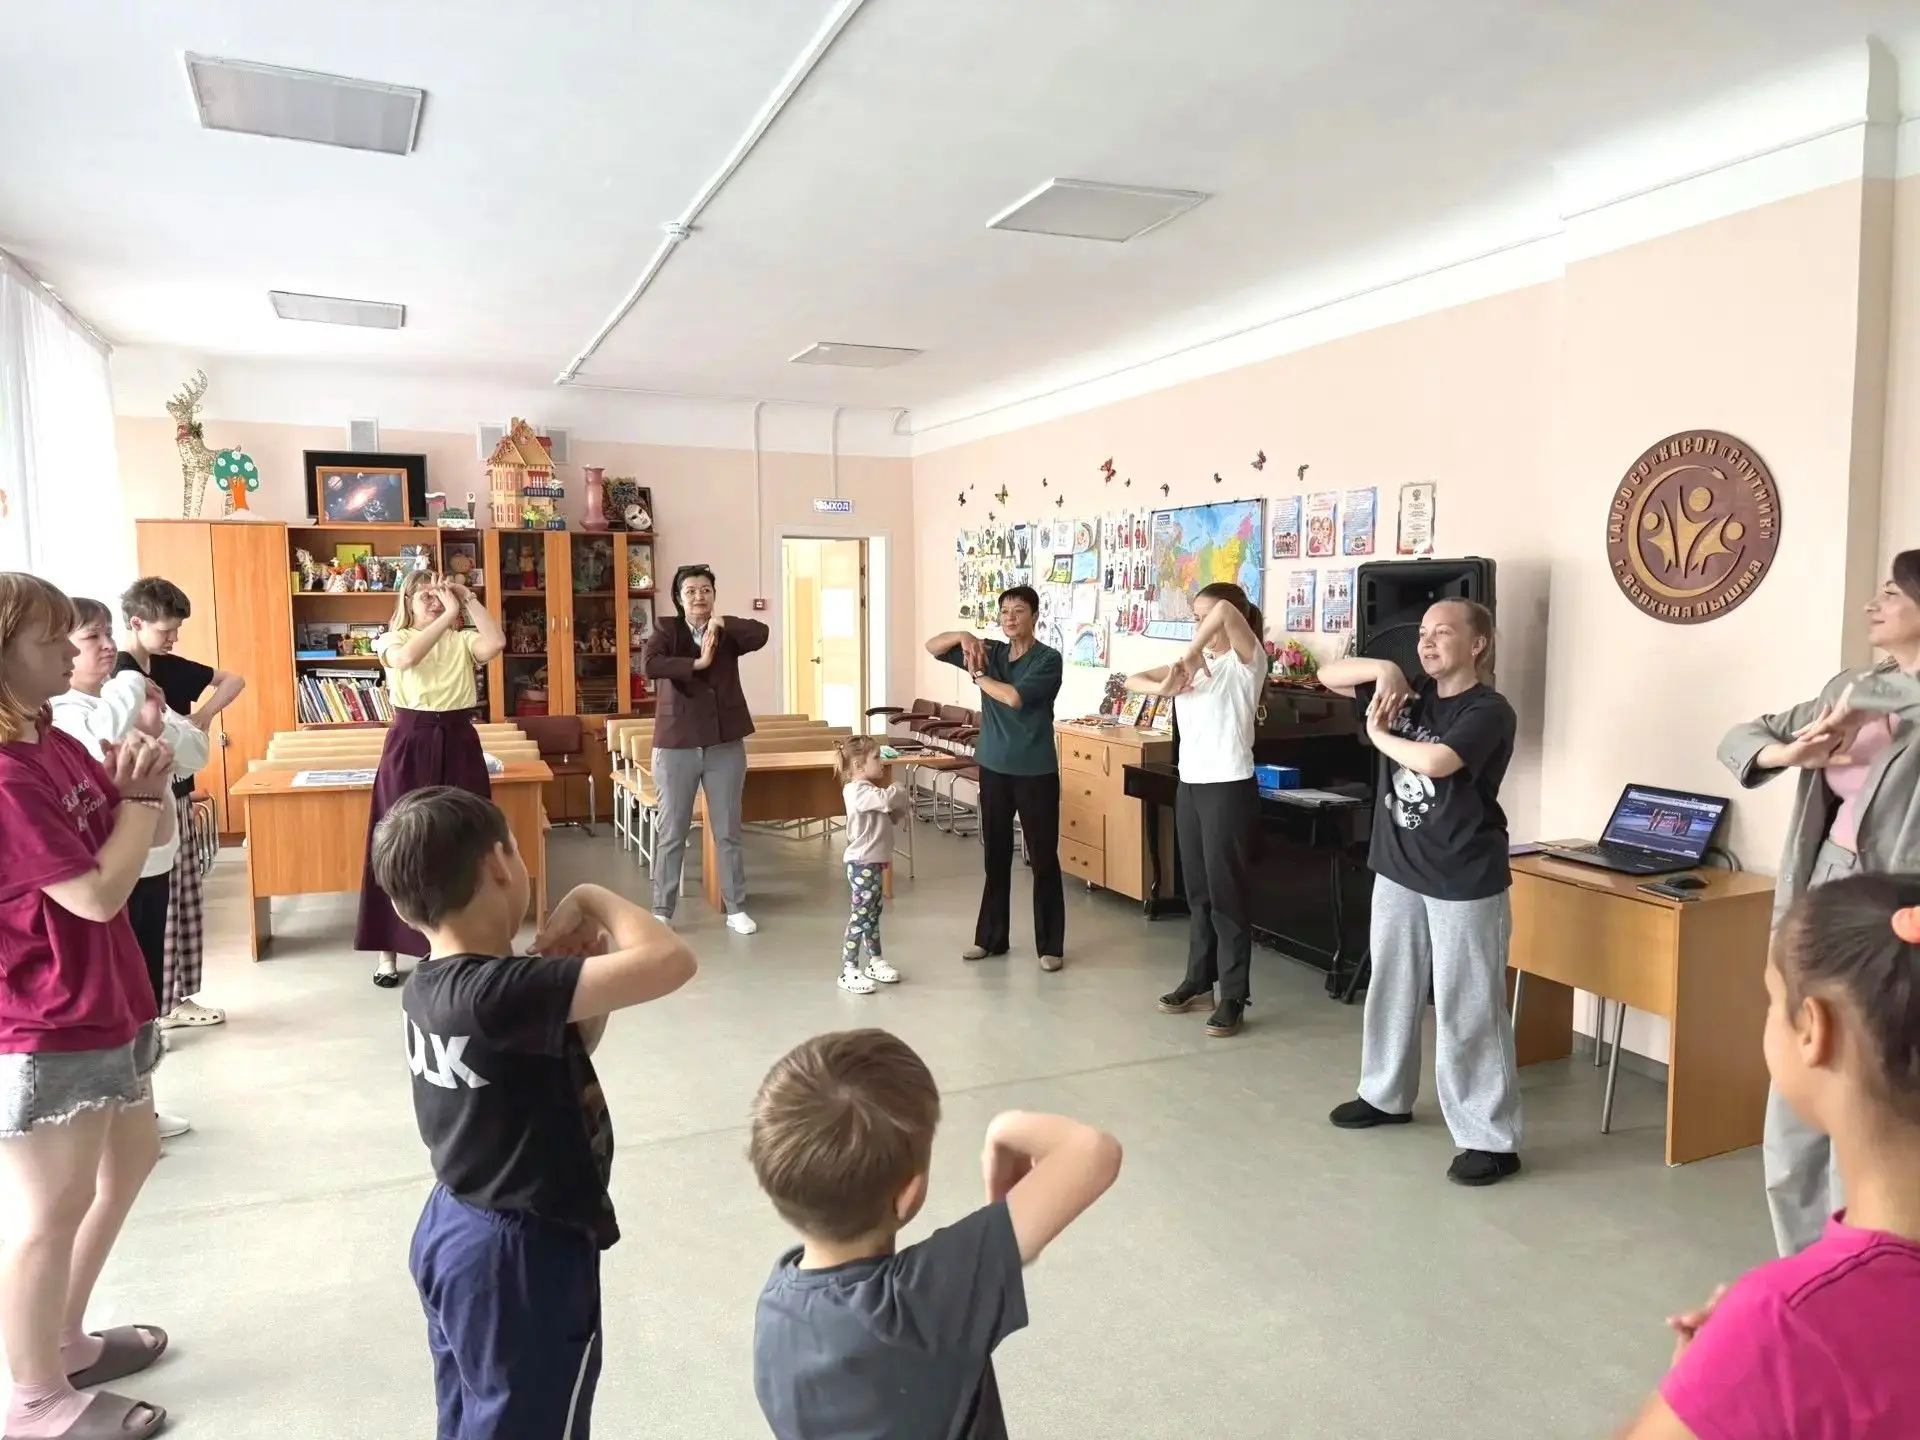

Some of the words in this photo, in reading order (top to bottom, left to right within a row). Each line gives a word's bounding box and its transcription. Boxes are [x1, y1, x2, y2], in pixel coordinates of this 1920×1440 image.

[1609, 487, 1633, 543] ГАУСО
[1630, 462, 1652, 486] СО
[1622, 572, 1693, 617] Верхняя
[1697, 559, 1764, 616] Пышма
